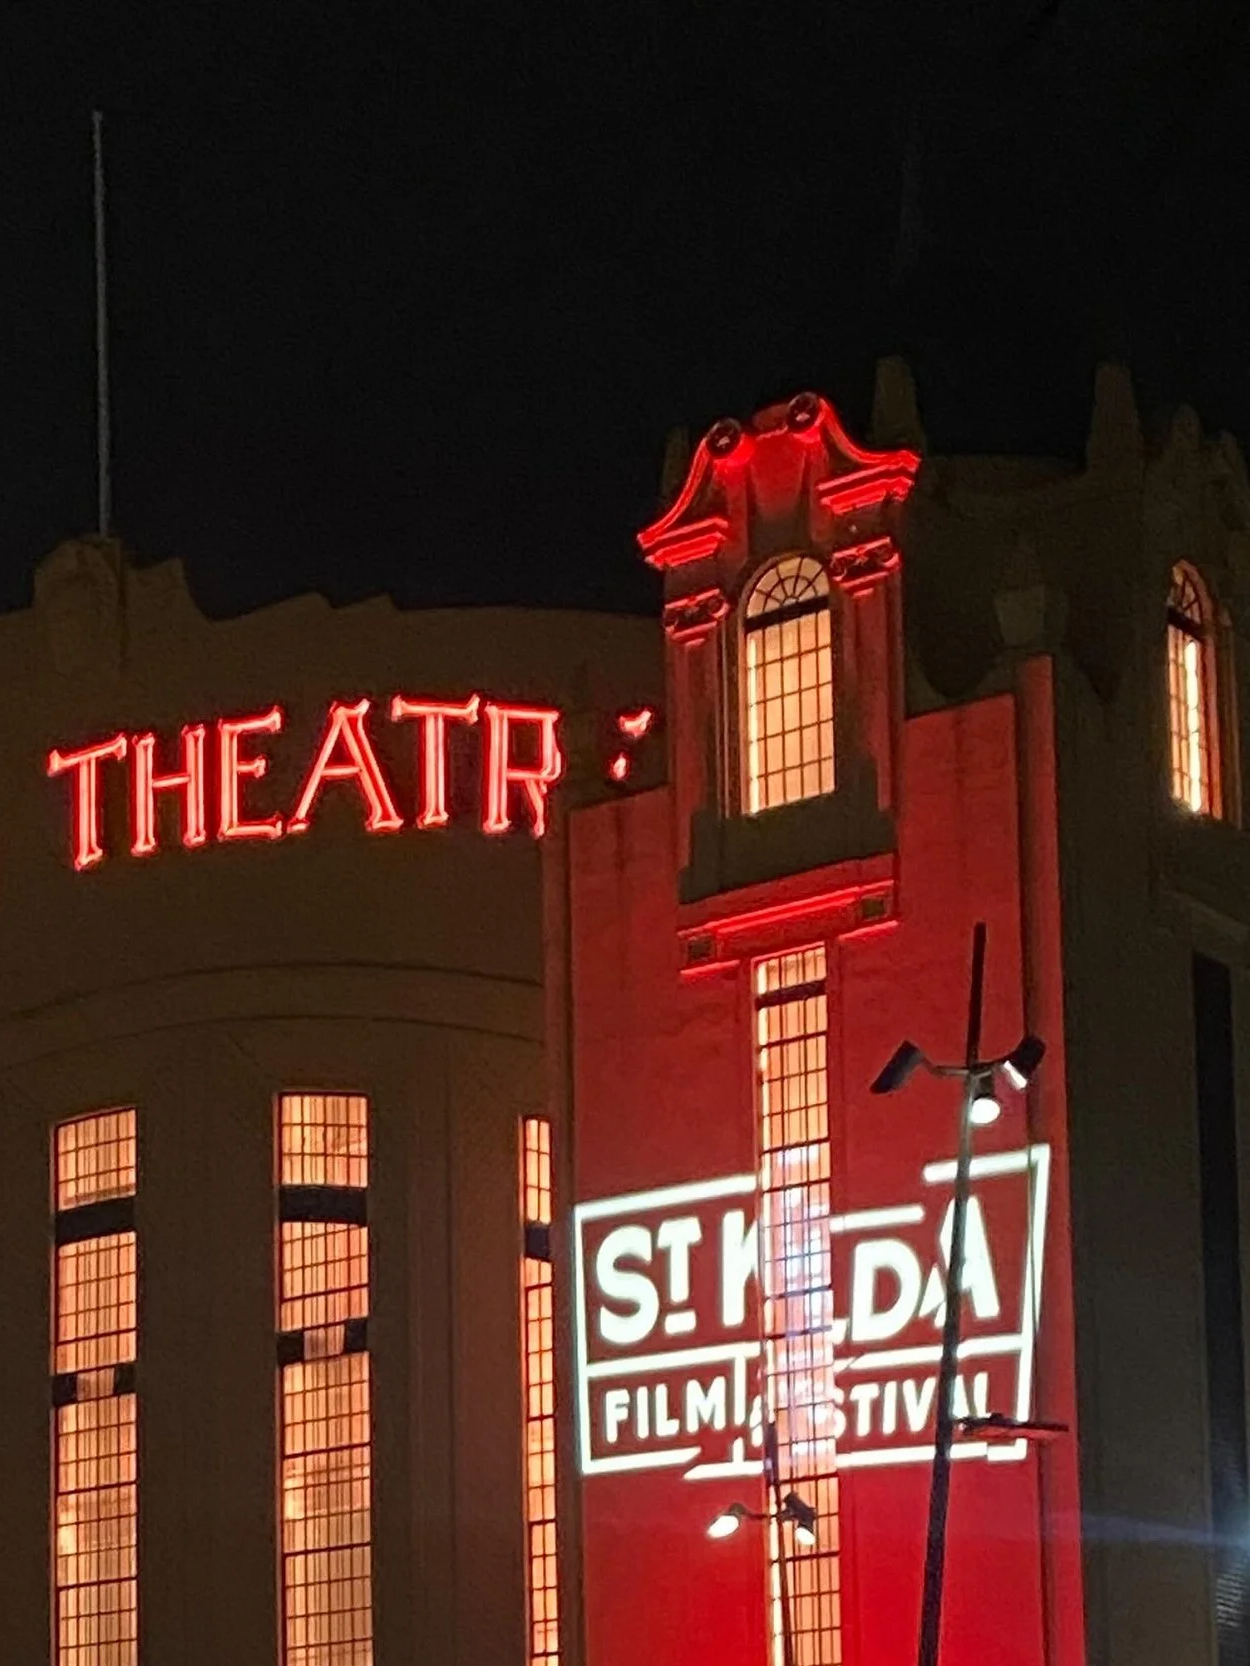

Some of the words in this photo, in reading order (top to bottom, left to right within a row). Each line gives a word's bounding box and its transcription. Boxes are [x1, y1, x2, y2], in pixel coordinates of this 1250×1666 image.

[722, 1195, 1000, 1343] KLDA
[604, 1375, 728, 1444] FILM
[750, 1370, 993, 1447] STIVAL
